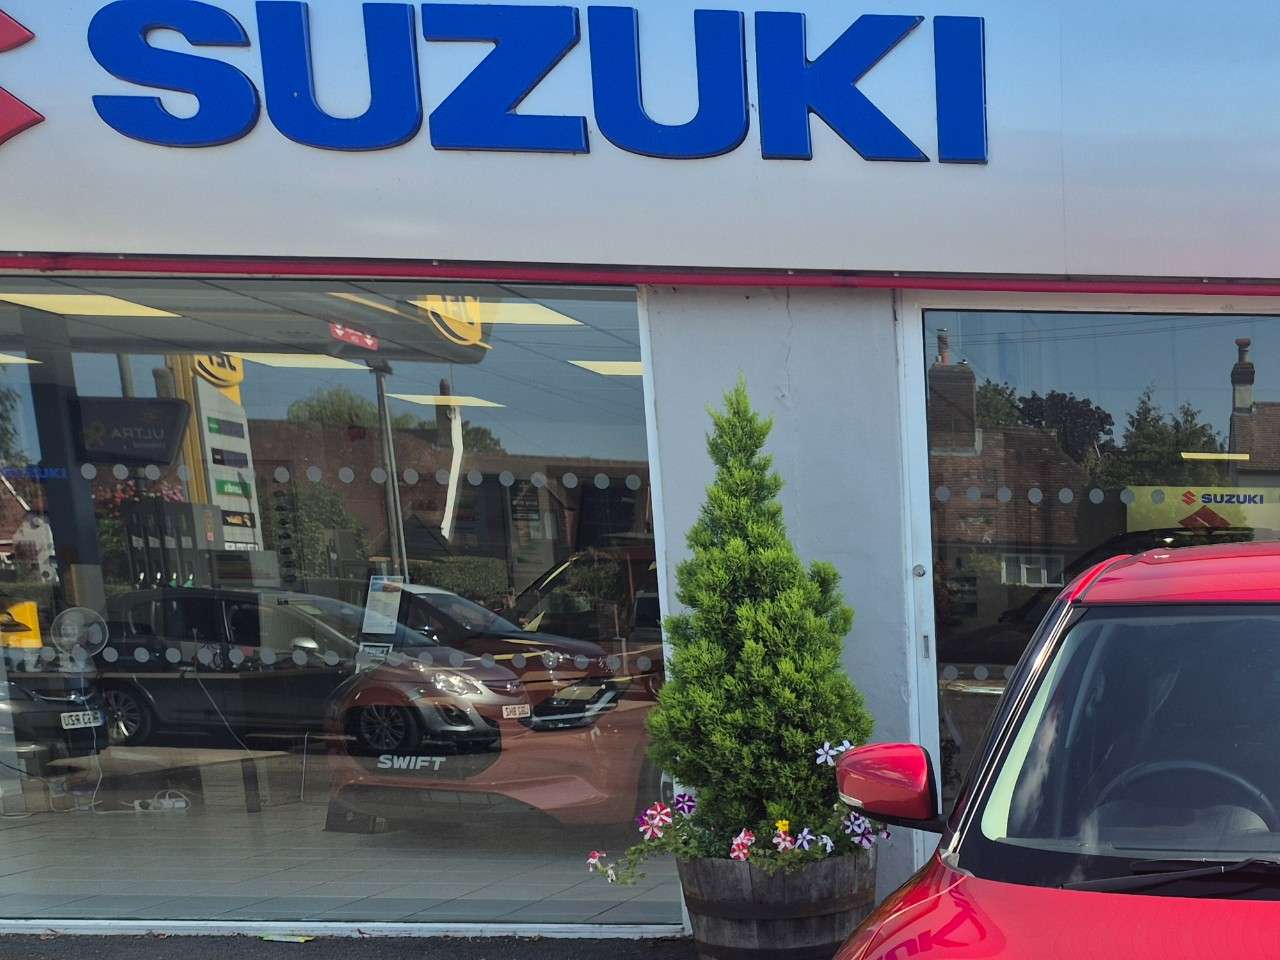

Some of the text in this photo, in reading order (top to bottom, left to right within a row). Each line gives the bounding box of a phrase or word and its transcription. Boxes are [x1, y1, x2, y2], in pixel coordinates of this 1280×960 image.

[87, 0, 987, 165] SUZUKI
[1201, 493, 1264, 505] SUZUKI
[377, 754, 447, 771] SWIFT
